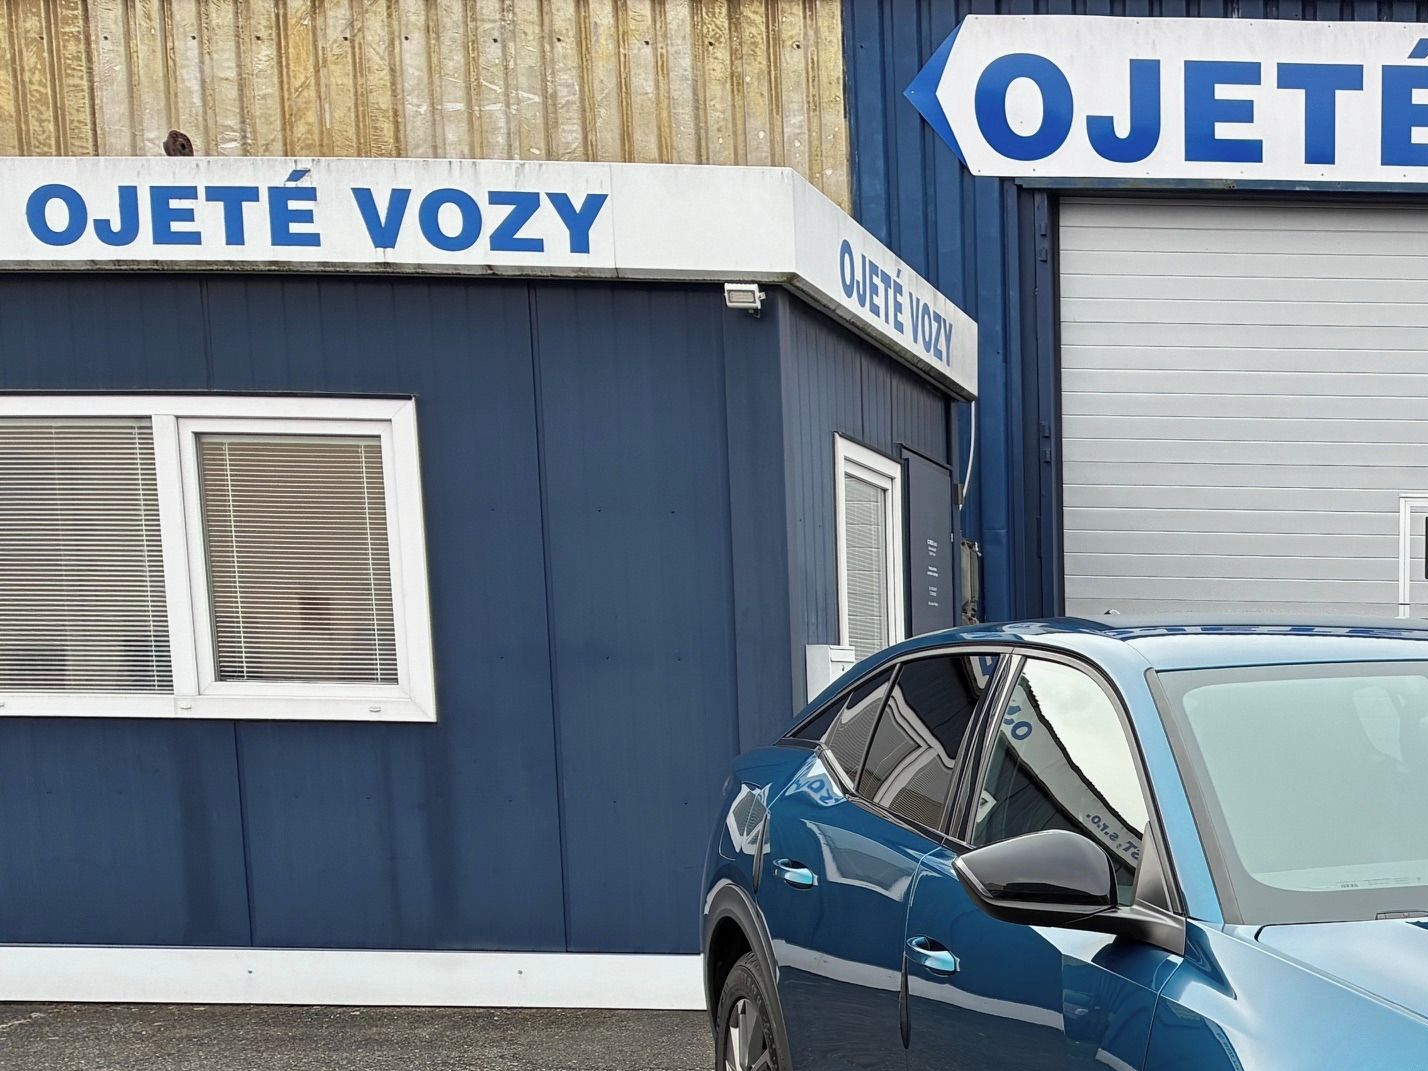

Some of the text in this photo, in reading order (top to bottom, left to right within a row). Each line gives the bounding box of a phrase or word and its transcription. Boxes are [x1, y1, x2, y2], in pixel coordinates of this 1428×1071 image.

[26, 169, 609, 254] OJETÉ VOZY
[839, 238, 953, 367] OJETÉ VOZY
